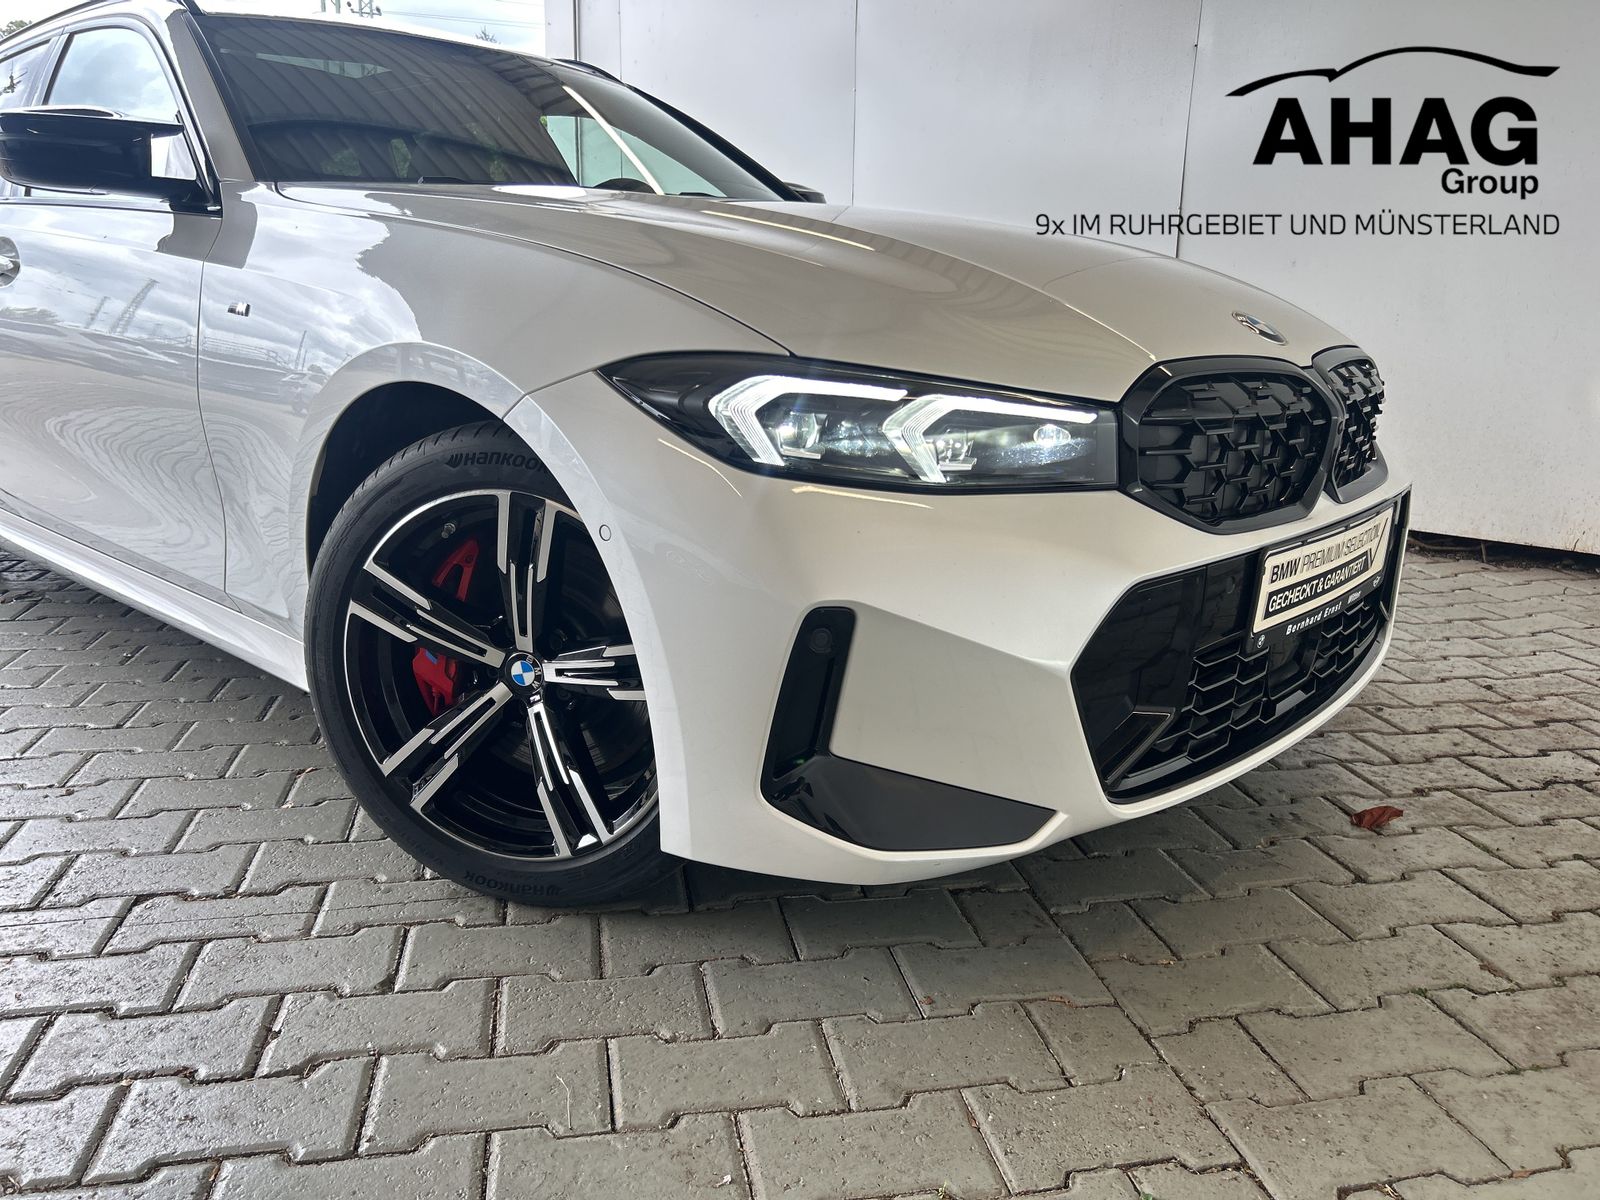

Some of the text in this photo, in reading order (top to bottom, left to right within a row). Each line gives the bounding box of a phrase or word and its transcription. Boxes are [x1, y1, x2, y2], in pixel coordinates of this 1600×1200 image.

[1270, 522, 1382, 584] BMW PREMIUM SELECTION
[1268, 556, 1367, 612] GECHECKT & GARANTIERT
[1286, 610, 1322, 635] Bernhard
[1323, 601, 1342, 619] Ernst
